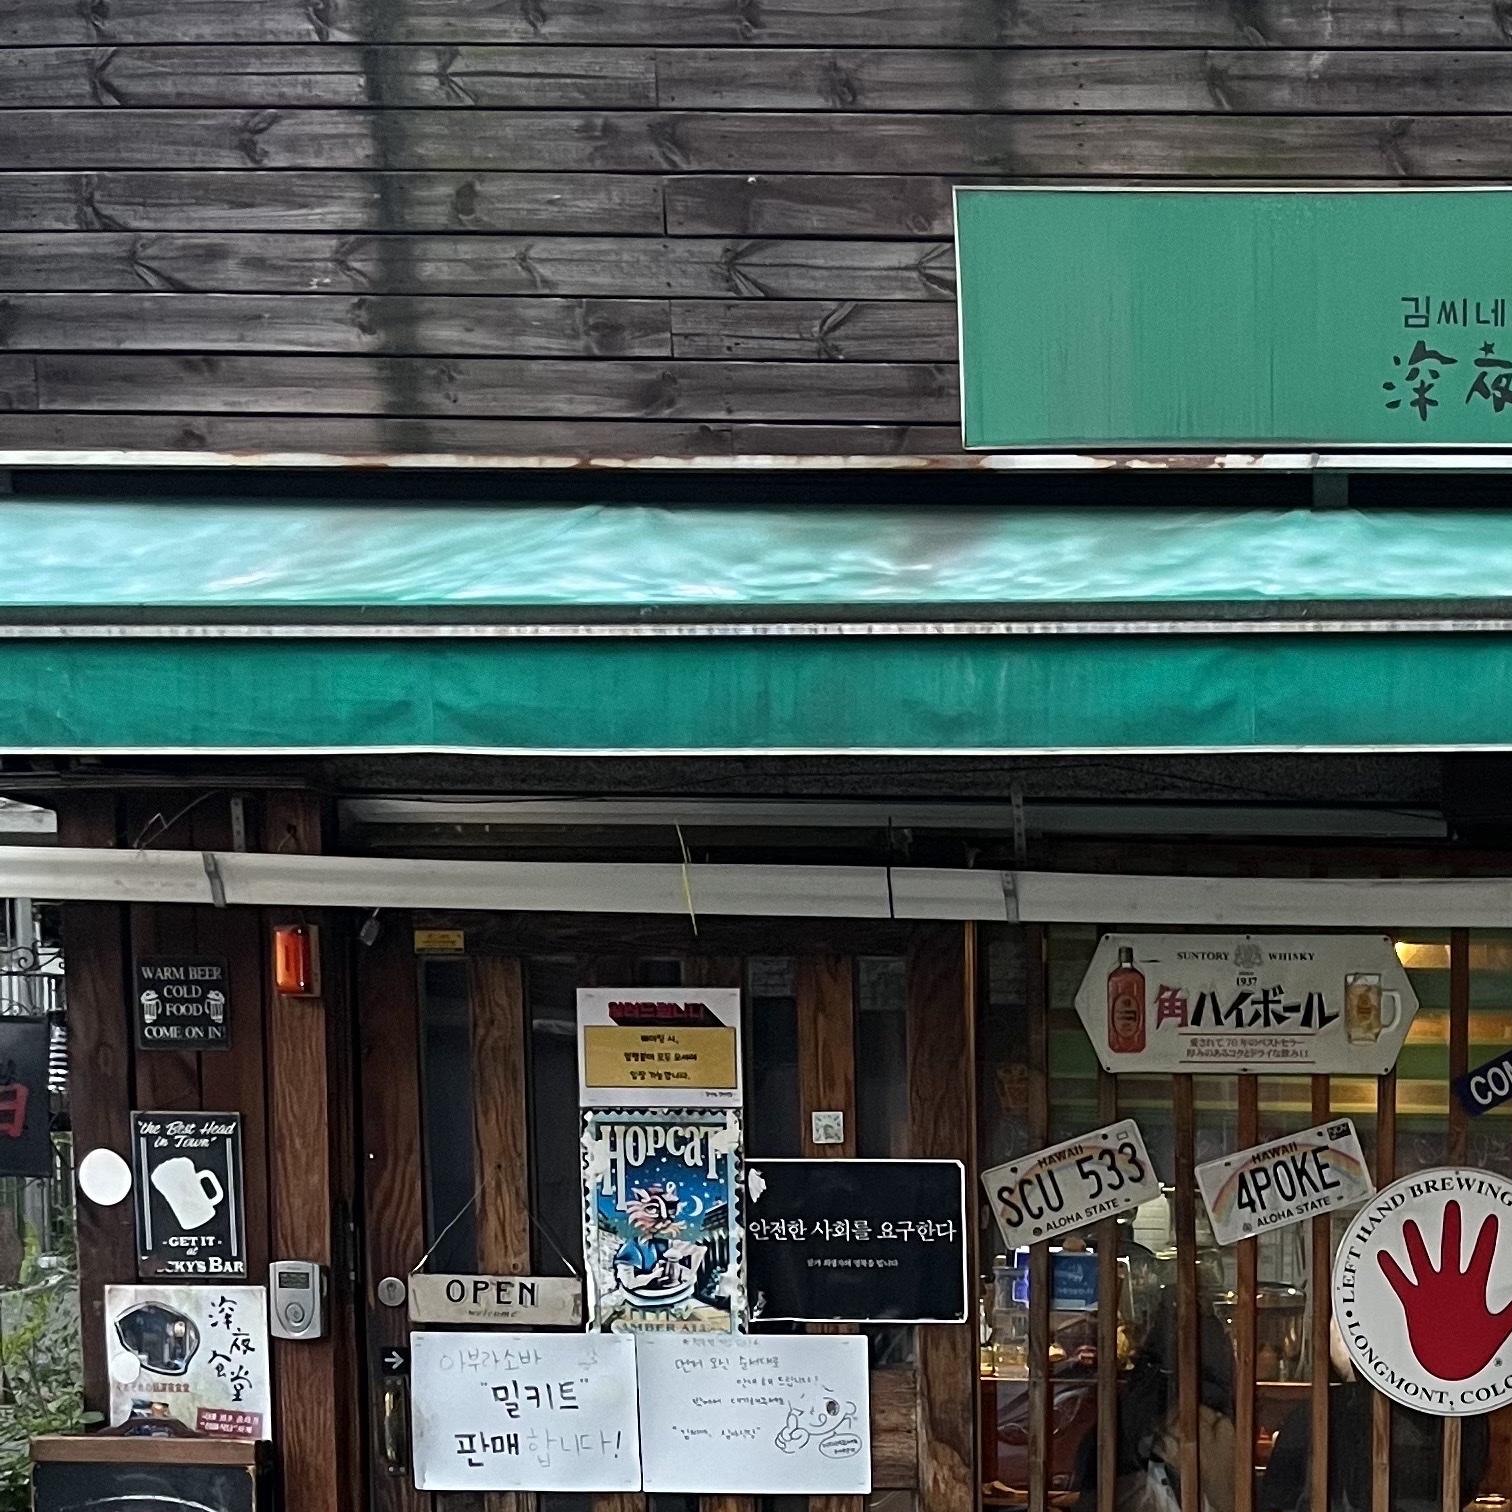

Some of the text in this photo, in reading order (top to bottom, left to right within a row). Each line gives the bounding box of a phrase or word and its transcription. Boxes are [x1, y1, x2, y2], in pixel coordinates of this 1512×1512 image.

[1177, 952, 1315, 961] SUNTORY WHISKY
[141, 966, 222, 981] WARM BEER
[1236, 977, 1258, 986] 1937
[163, 985, 202, 998] COLD
[165, 1003, 203, 1016] FOOD
[1154, 983, 1340, 1030] 角ハイボール
[144, 1026, 181, 1039] COME
[185, 1026, 205, 1039] ON
[165, 1121, 196, 1136] Best
[201, 1121, 236, 1135] Head
[1037, 1146, 1083, 1168] HAWAII
[1252, 1141, 1298, 1164] HAWAII
[997, 1142, 1146, 1228] SCU 533
[1236, 1145, 1340, 1214] 4POKE
[1046, 1203, 1119, 1232] ALOHA STATE
[1257, 1197, 1331, 1228] ALOHA STATE
[749, 1218, 957, 1243] 안전한 사회를 요구한다
[186, 1245, 198, 1255] at
[1343, 1246, 1362, 1303] LEFT
[1356, 1193, 1405, 1243] HAND
[446, 1279, 537, 1306] OPEN
[468, 1310, 518, 1318] welcome
[439, 1348, 542, 1373] 아부라소바
[1348, 1320, 1454, 1406] LONGMONT,
